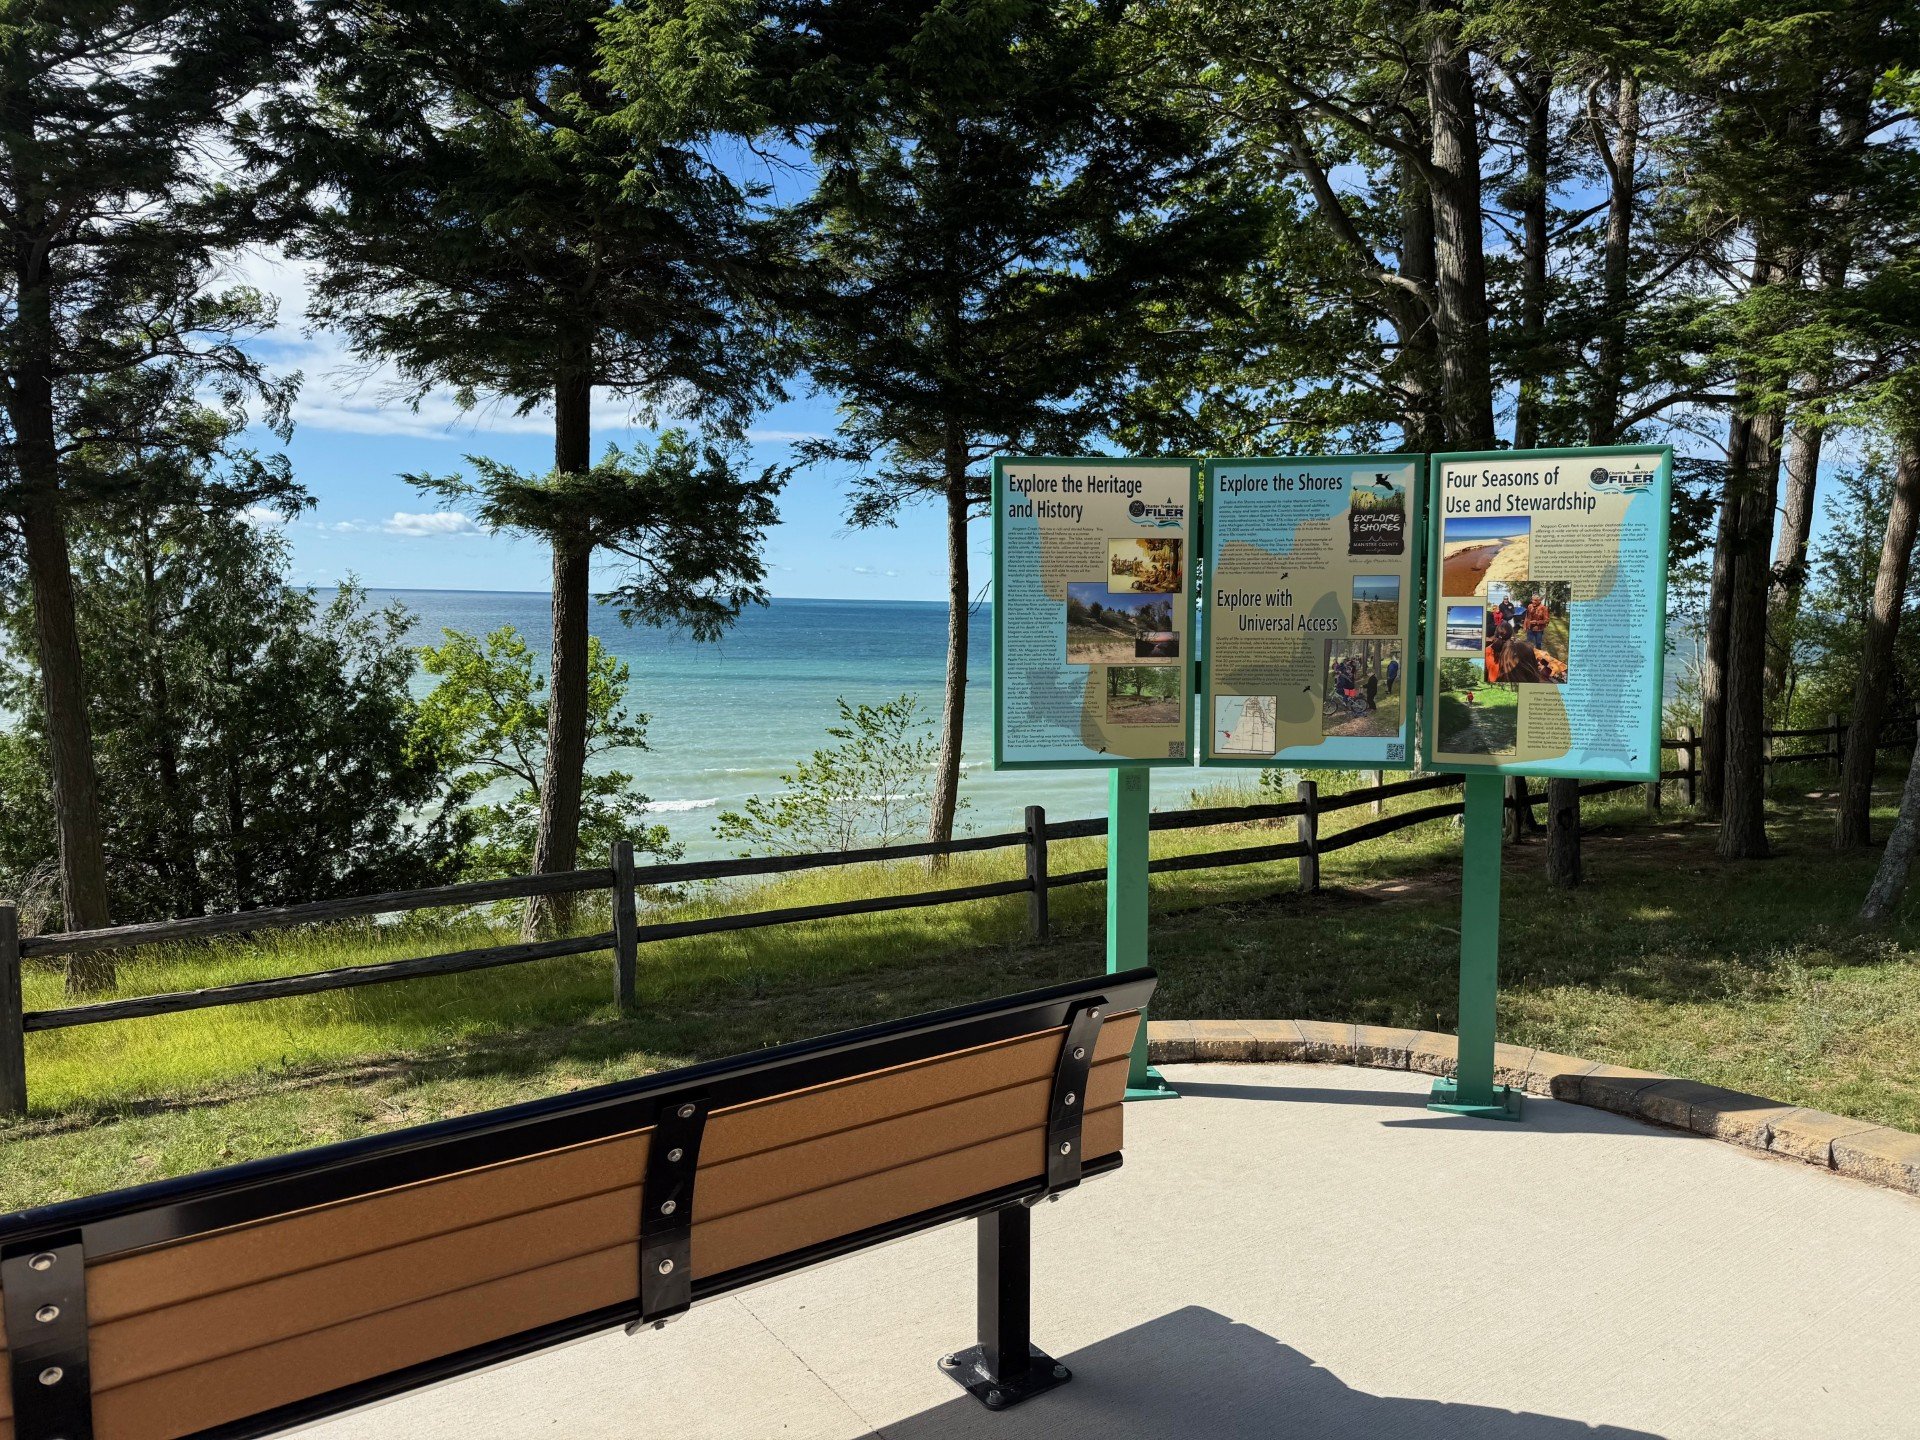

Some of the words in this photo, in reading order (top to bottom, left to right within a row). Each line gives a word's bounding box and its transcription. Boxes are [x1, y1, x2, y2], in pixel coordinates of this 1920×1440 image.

[1009, 474, 1057, 497] Explore
[1062, 474, 1082, 493] the
[1087, 475, 1142, 498] Heritage
[1220, 475, 1268, 496] Explore
[1272, 474, 1294, 490] the
[1298, 473, 1342, 490] Shores
[1446, 472, 1477, 488] Four
[1482, 470, 1539, 487] Seasons
[1544, 466, 1560, 485] of
[1609, 475, 1654, 483] FILER
[1008, 500, 1032, 518] and
[1038, 500, 1082, 522] History
[1446, 496, 1470, 513] Use
[1475, 494, 1501, 512] and
[1506, 491, 1597, 514] Stewardship
[1353, 514, 1400, 523] EXPLORE
[1360, 523, 1400, 532] SHORES
[1217, 589, 1262, 611] Explore
[1266, 589, 1292, 606] with
[1239, 614, 1294, 631] Universal
[1298, 614, 1338, 631] Access
